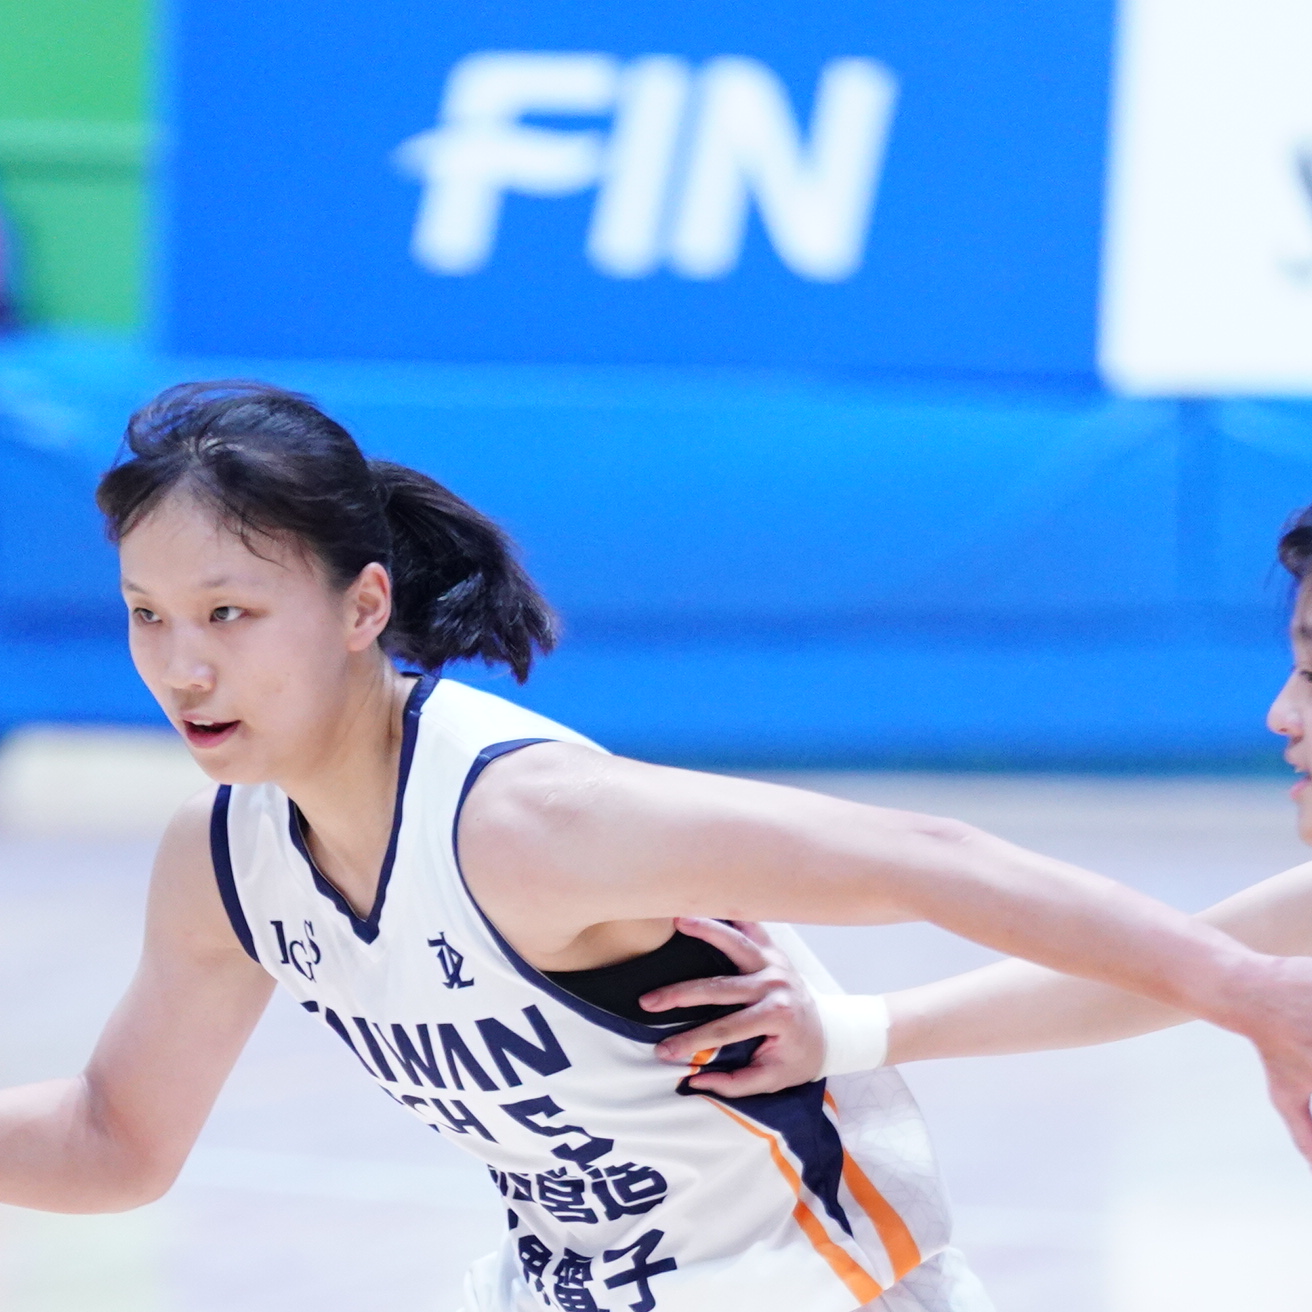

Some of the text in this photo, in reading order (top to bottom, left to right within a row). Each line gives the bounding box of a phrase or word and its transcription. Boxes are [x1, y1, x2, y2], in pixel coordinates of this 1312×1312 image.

[393, 50, 899, 282] FIN
[300, 1000, 572, 1092] AIWAN
[499, 1094, 614, 1171] 5
